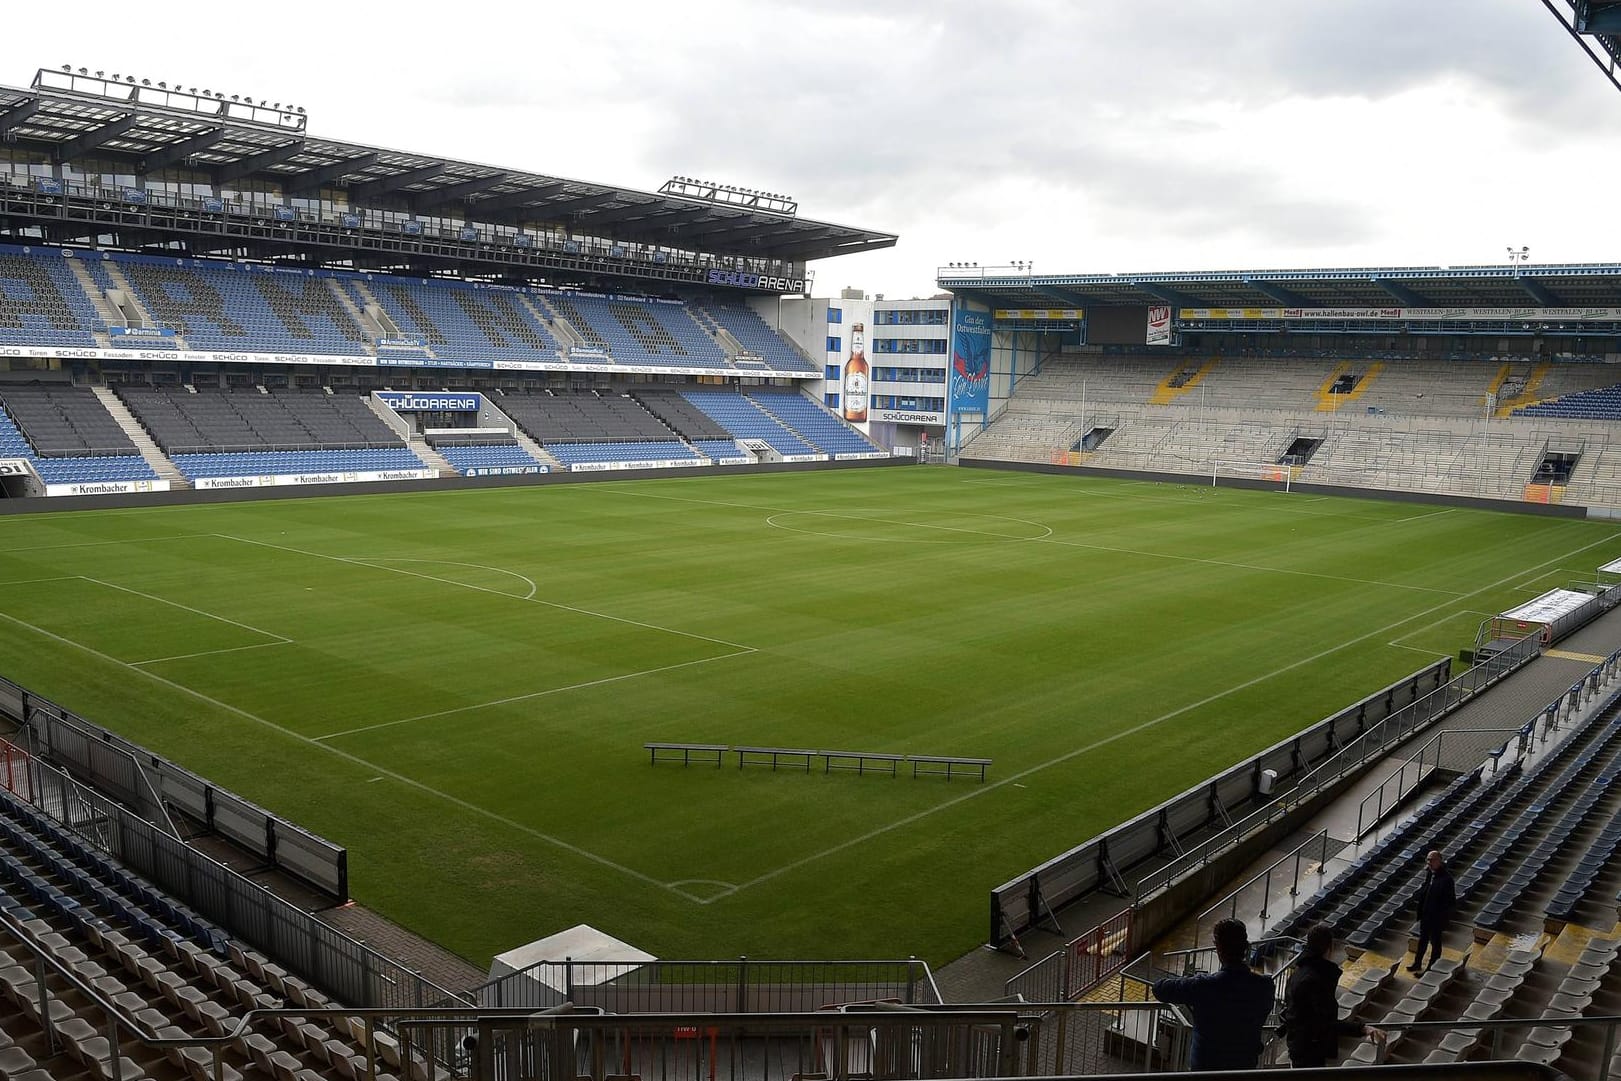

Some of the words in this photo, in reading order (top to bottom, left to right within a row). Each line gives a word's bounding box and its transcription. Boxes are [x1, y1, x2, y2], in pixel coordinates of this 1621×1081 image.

[964, 315, 975, 324] Gin
[956, 323, 991, 335] Ostwestfalen
[55, 349, 97, 358] SCHÜCO
[139, 352, 178, 360] SCHÜCO
[212, 353, 248, 361] SCHÜCO
[274, 355, 308, 363] SCHÜCO
[341, 357, 373, 365] SCHÜCO
[883, 412, 938, 422] SCHÜCOARENA
[300, 474, 339, 484] Krombacher
[383, 471, 418, 480] Krombacher
[210, 478, 254, 487] Krombacher
[79, 483, 128, 495] Krombacher
